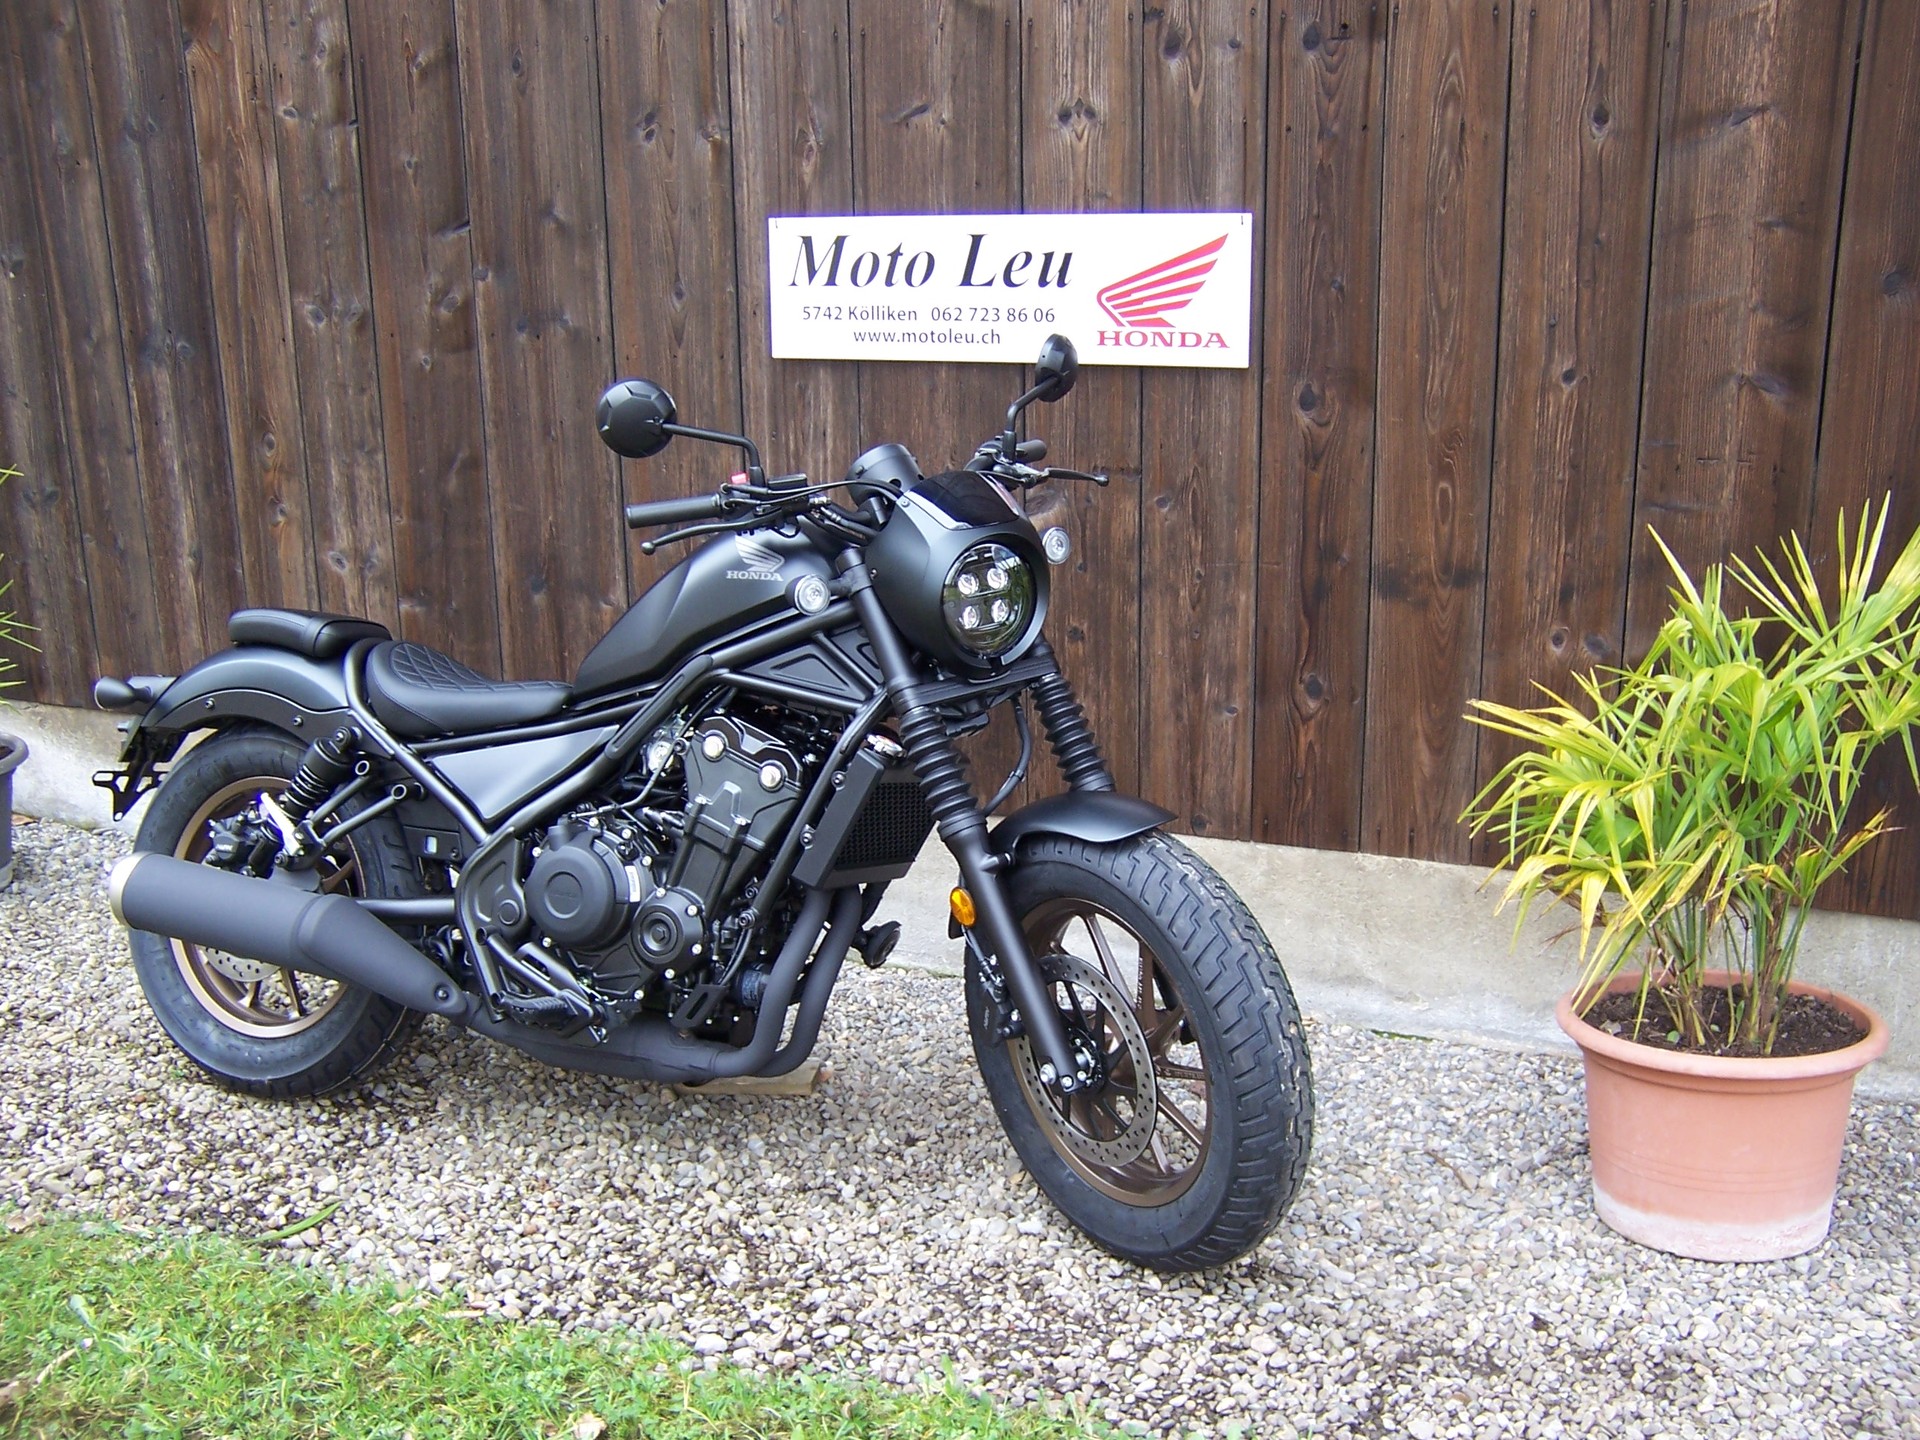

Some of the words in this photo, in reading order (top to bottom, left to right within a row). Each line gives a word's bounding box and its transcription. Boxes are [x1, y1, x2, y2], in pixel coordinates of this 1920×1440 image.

[788, 234, 936, 288] Moto
[957, 233, 1073, 289] Leu
[803, 306, 842, 321] 5742
[848, 305, 918, 322] Kölliken
[931, 307, 963, 322] 062
[969, 307, 1000, 322] 723
[1006, 307, 1028, 323] 86
[1033, 307, 1056, 323] 06
[853, 328, 1001, 345] www.motoleu.ch
[1097, 330, 1230, 349] HONDA
[726, 570, 784, 582] HONDA
